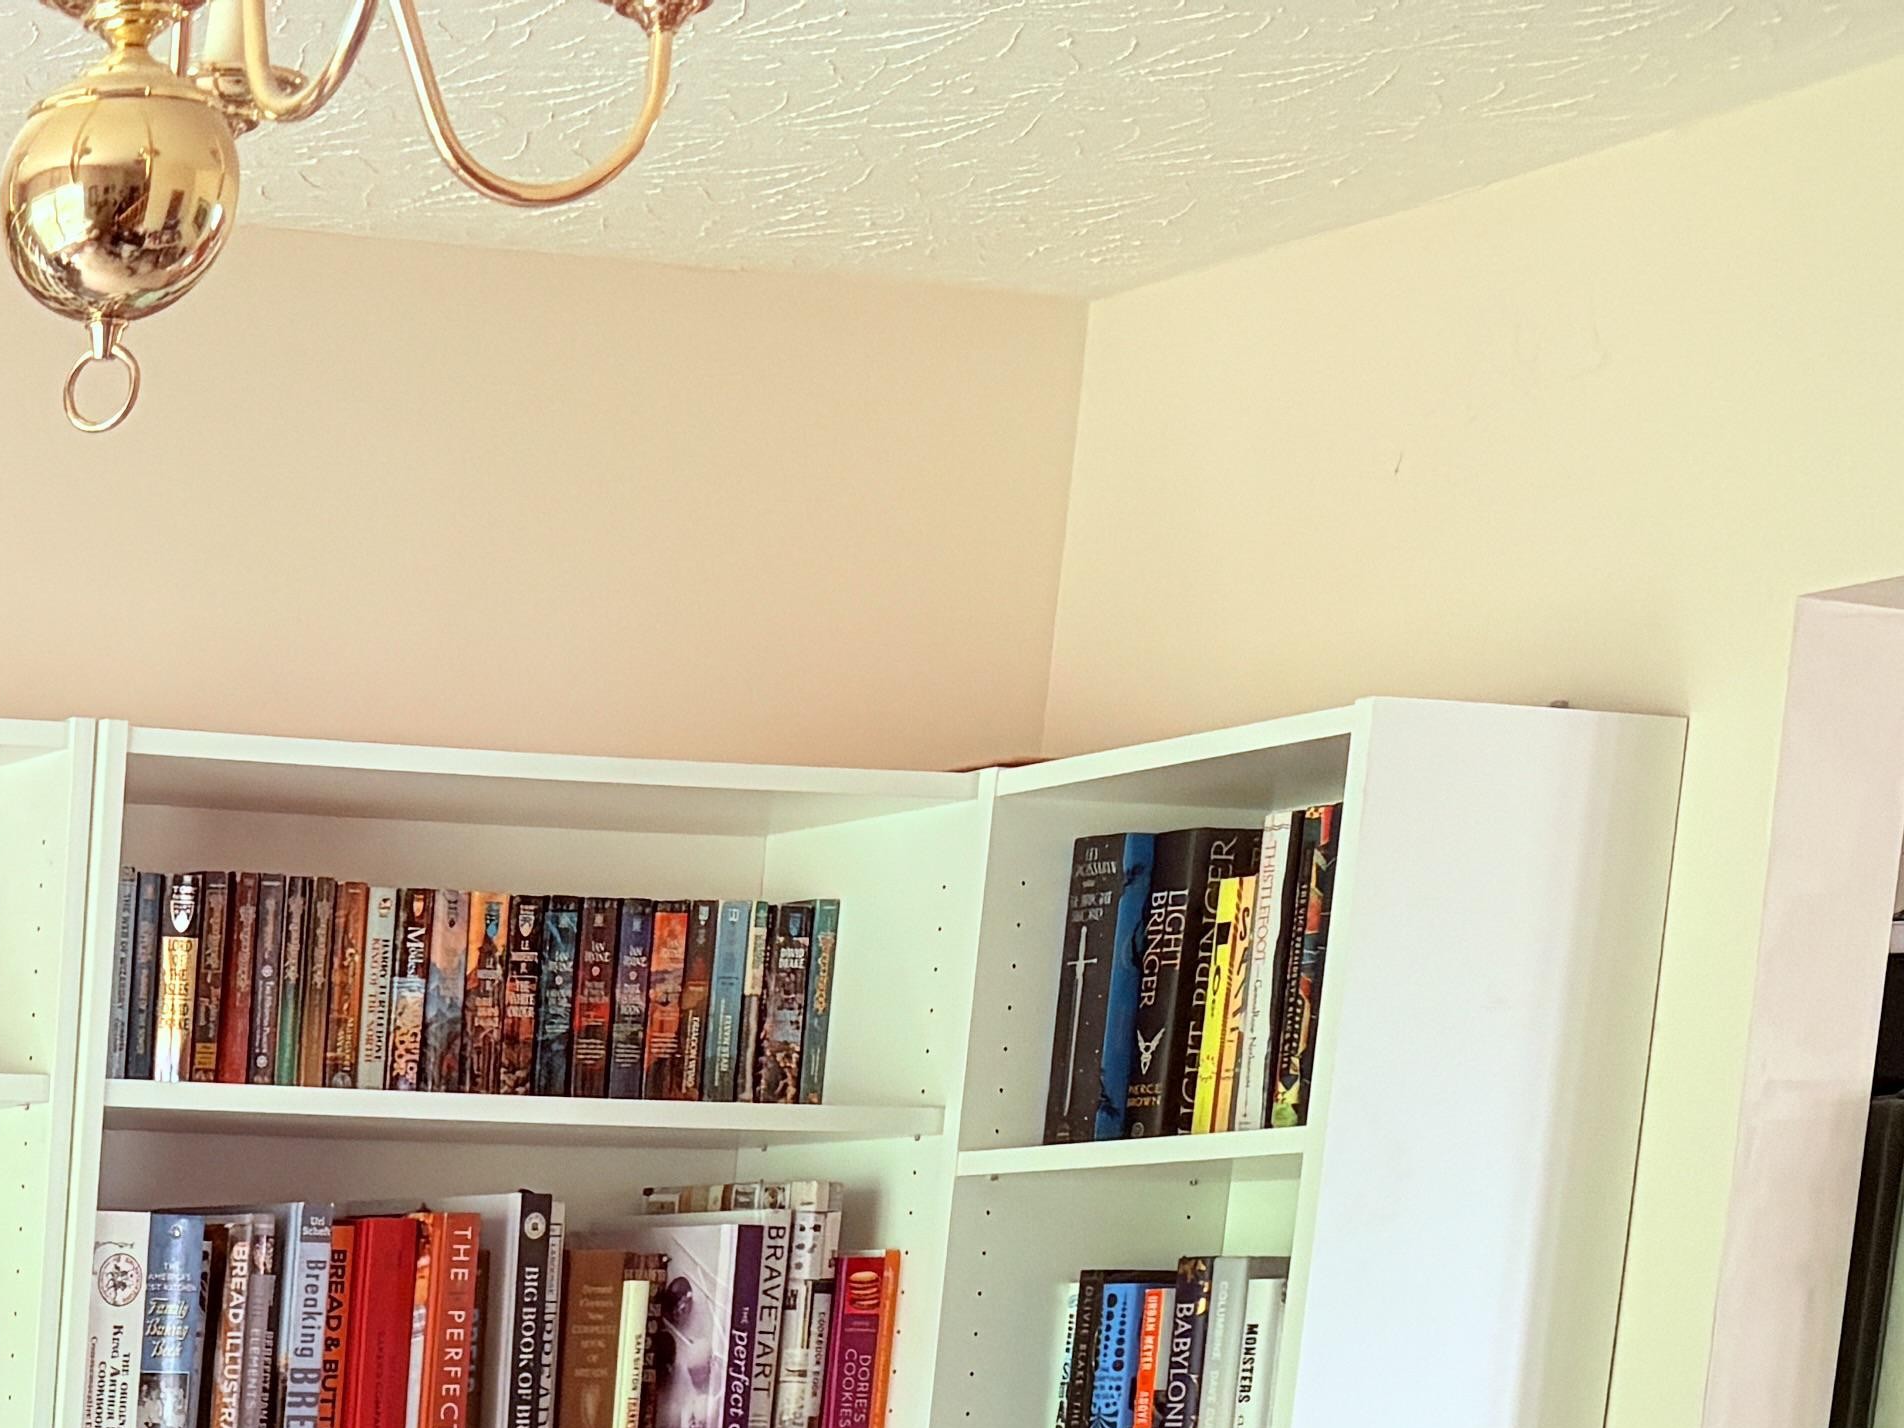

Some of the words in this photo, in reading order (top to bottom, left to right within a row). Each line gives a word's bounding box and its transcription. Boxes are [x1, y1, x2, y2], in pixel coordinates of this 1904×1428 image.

[1139, 891, 1166, 1008] BRINGER
[1162, 888, 1188, 970] LIGHT
[449, 1227, 472, 1281] THE
[523, 1266, 540, 1304] BIG
[519, 1307, 538, 1368] BOOK
[753, 1225, 786, 1398] BRAVETART
[839, 1348, 858, 1428] COOKIES
[1238, 1322, 1259, 1403] MONSTERS
